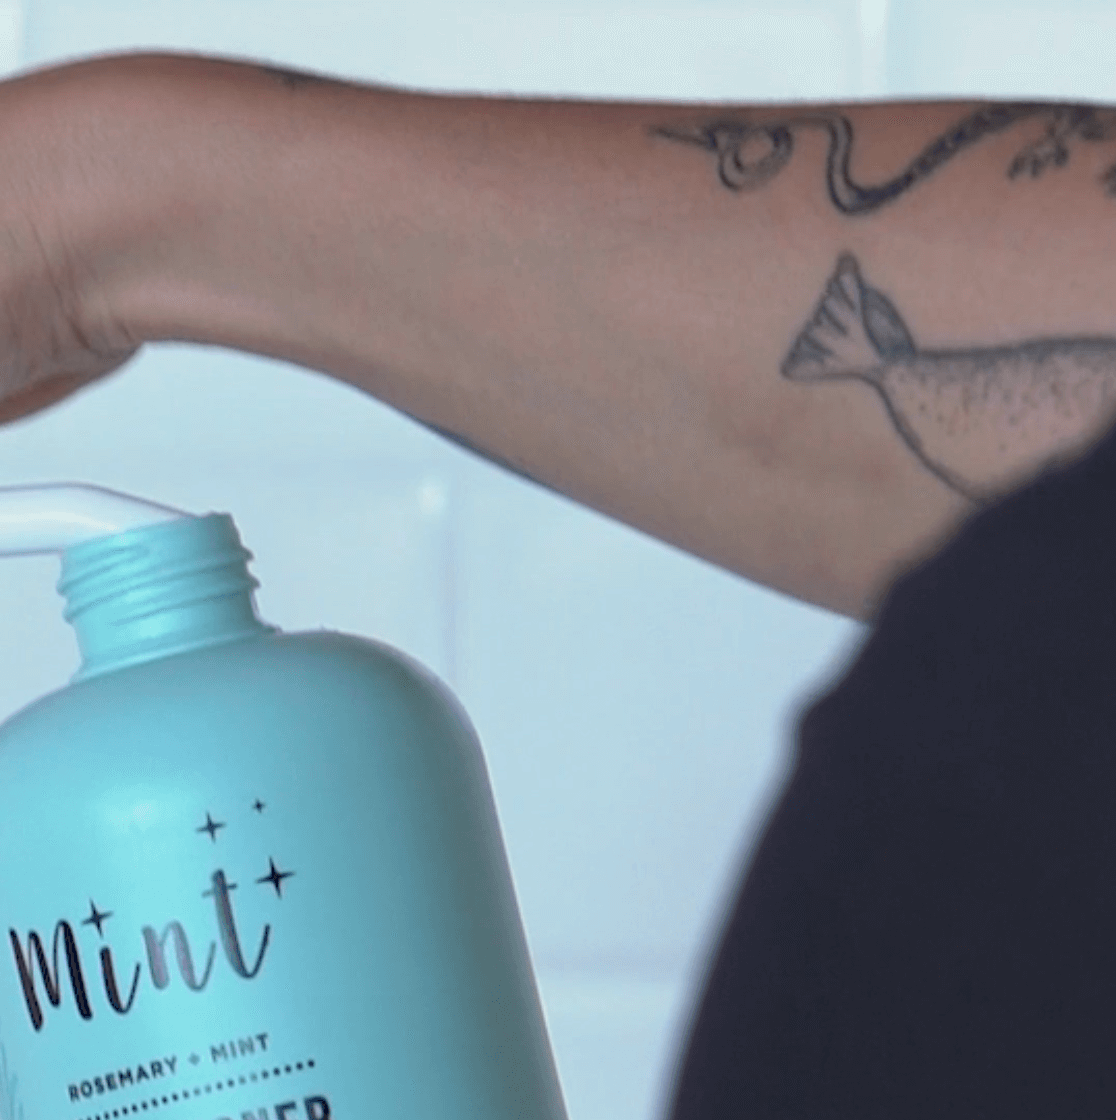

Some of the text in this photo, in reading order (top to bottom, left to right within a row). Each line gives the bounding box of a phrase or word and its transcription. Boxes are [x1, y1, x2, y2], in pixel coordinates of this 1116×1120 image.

[9, 869, 271, 1032] Mint
[68, 1055, 178, 1102] ROSEMARY
[210, 1033, 269, 1063] MINT
